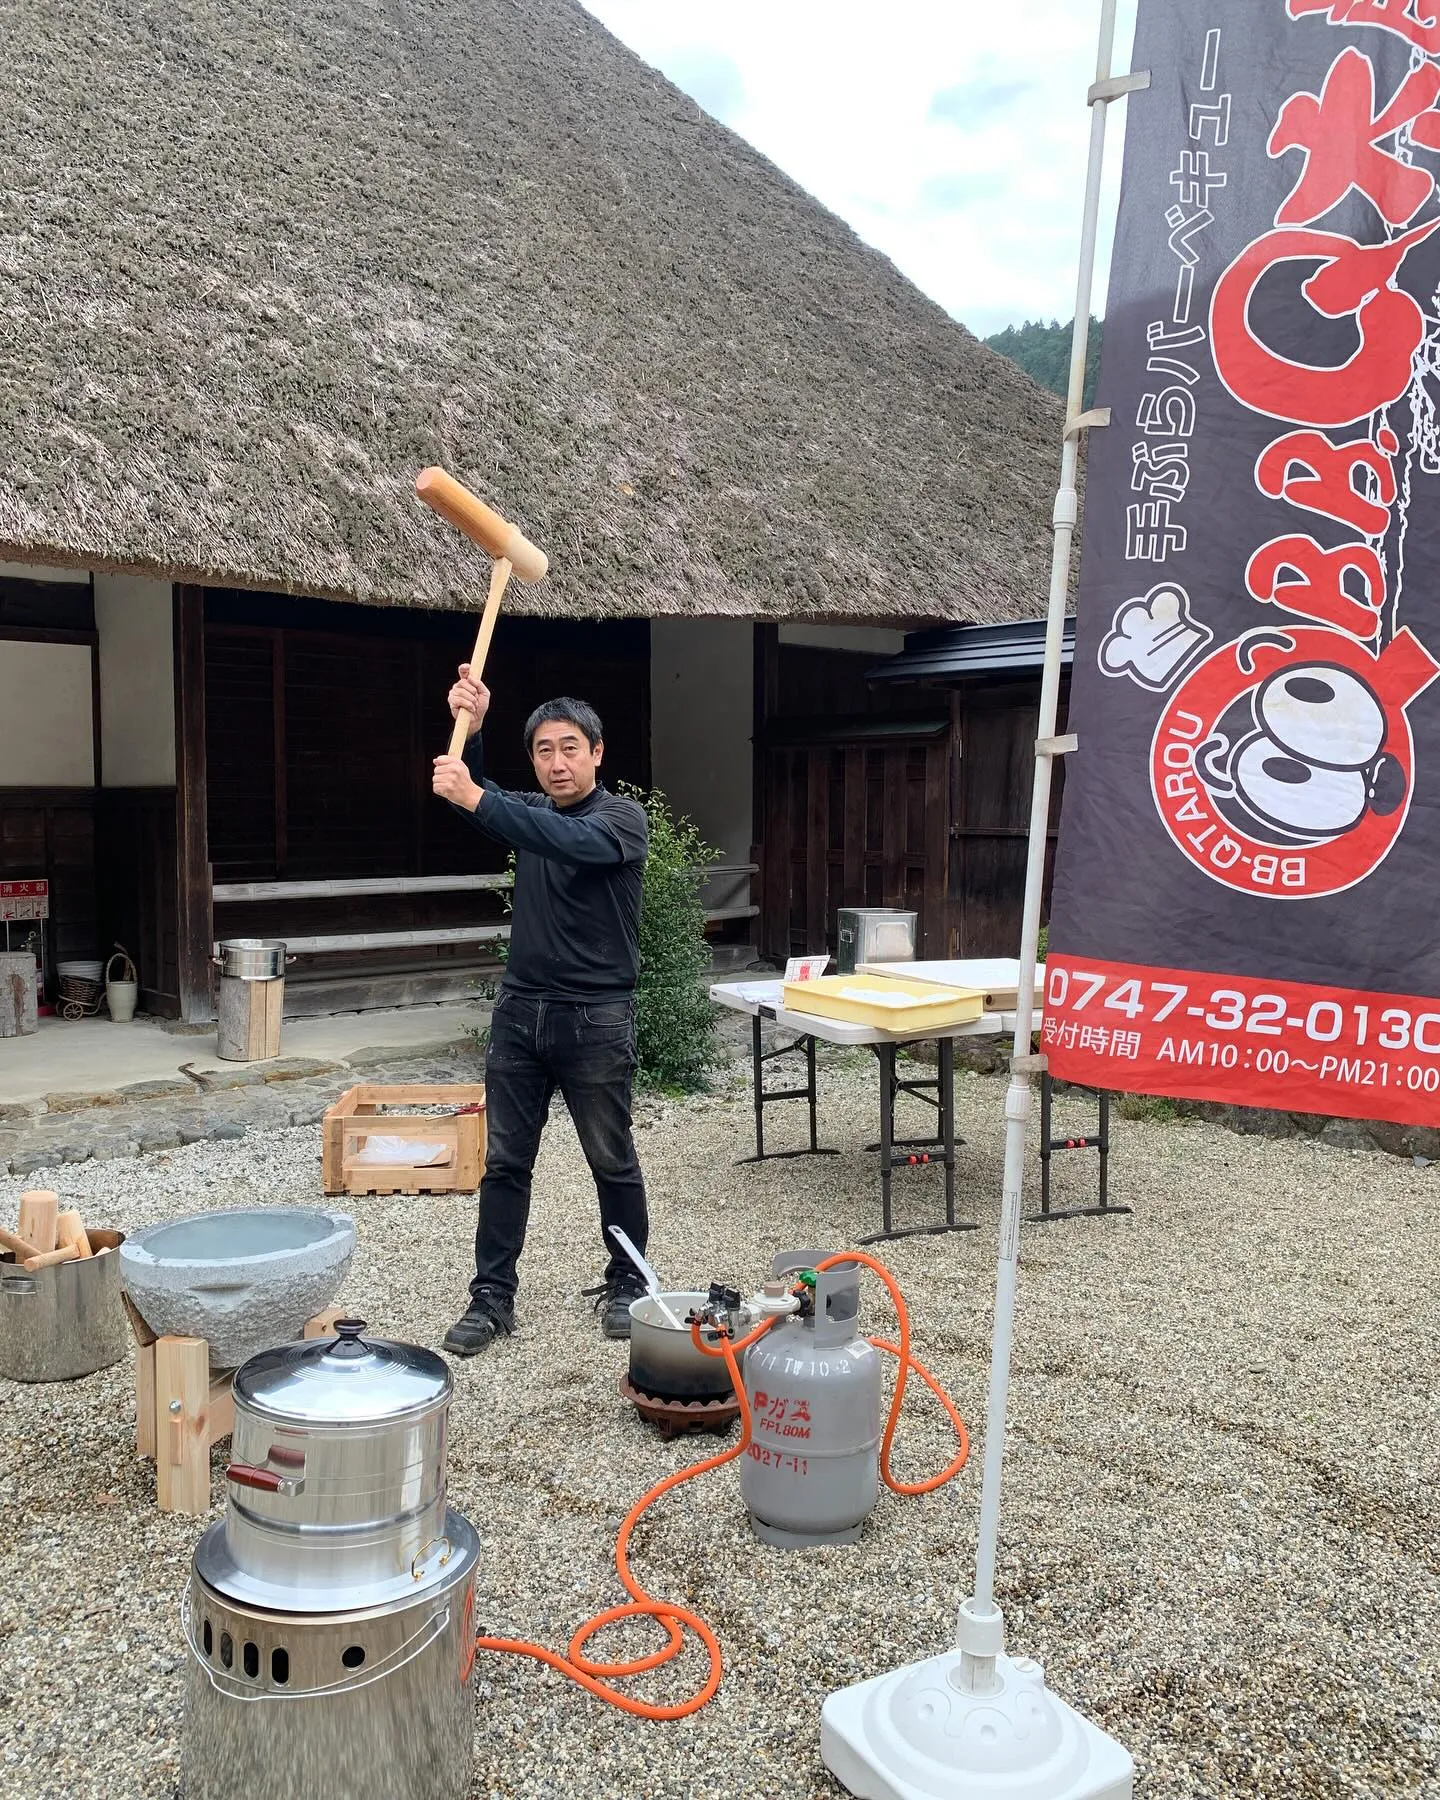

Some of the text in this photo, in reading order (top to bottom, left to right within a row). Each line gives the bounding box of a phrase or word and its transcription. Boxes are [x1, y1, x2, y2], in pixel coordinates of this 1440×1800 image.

[1126, 28, 1231, 562] 手ぶらバーベキュー
[3, 882, 45, 893] 消火器
[1042, 1017, 1142, 1060] 受付時間
